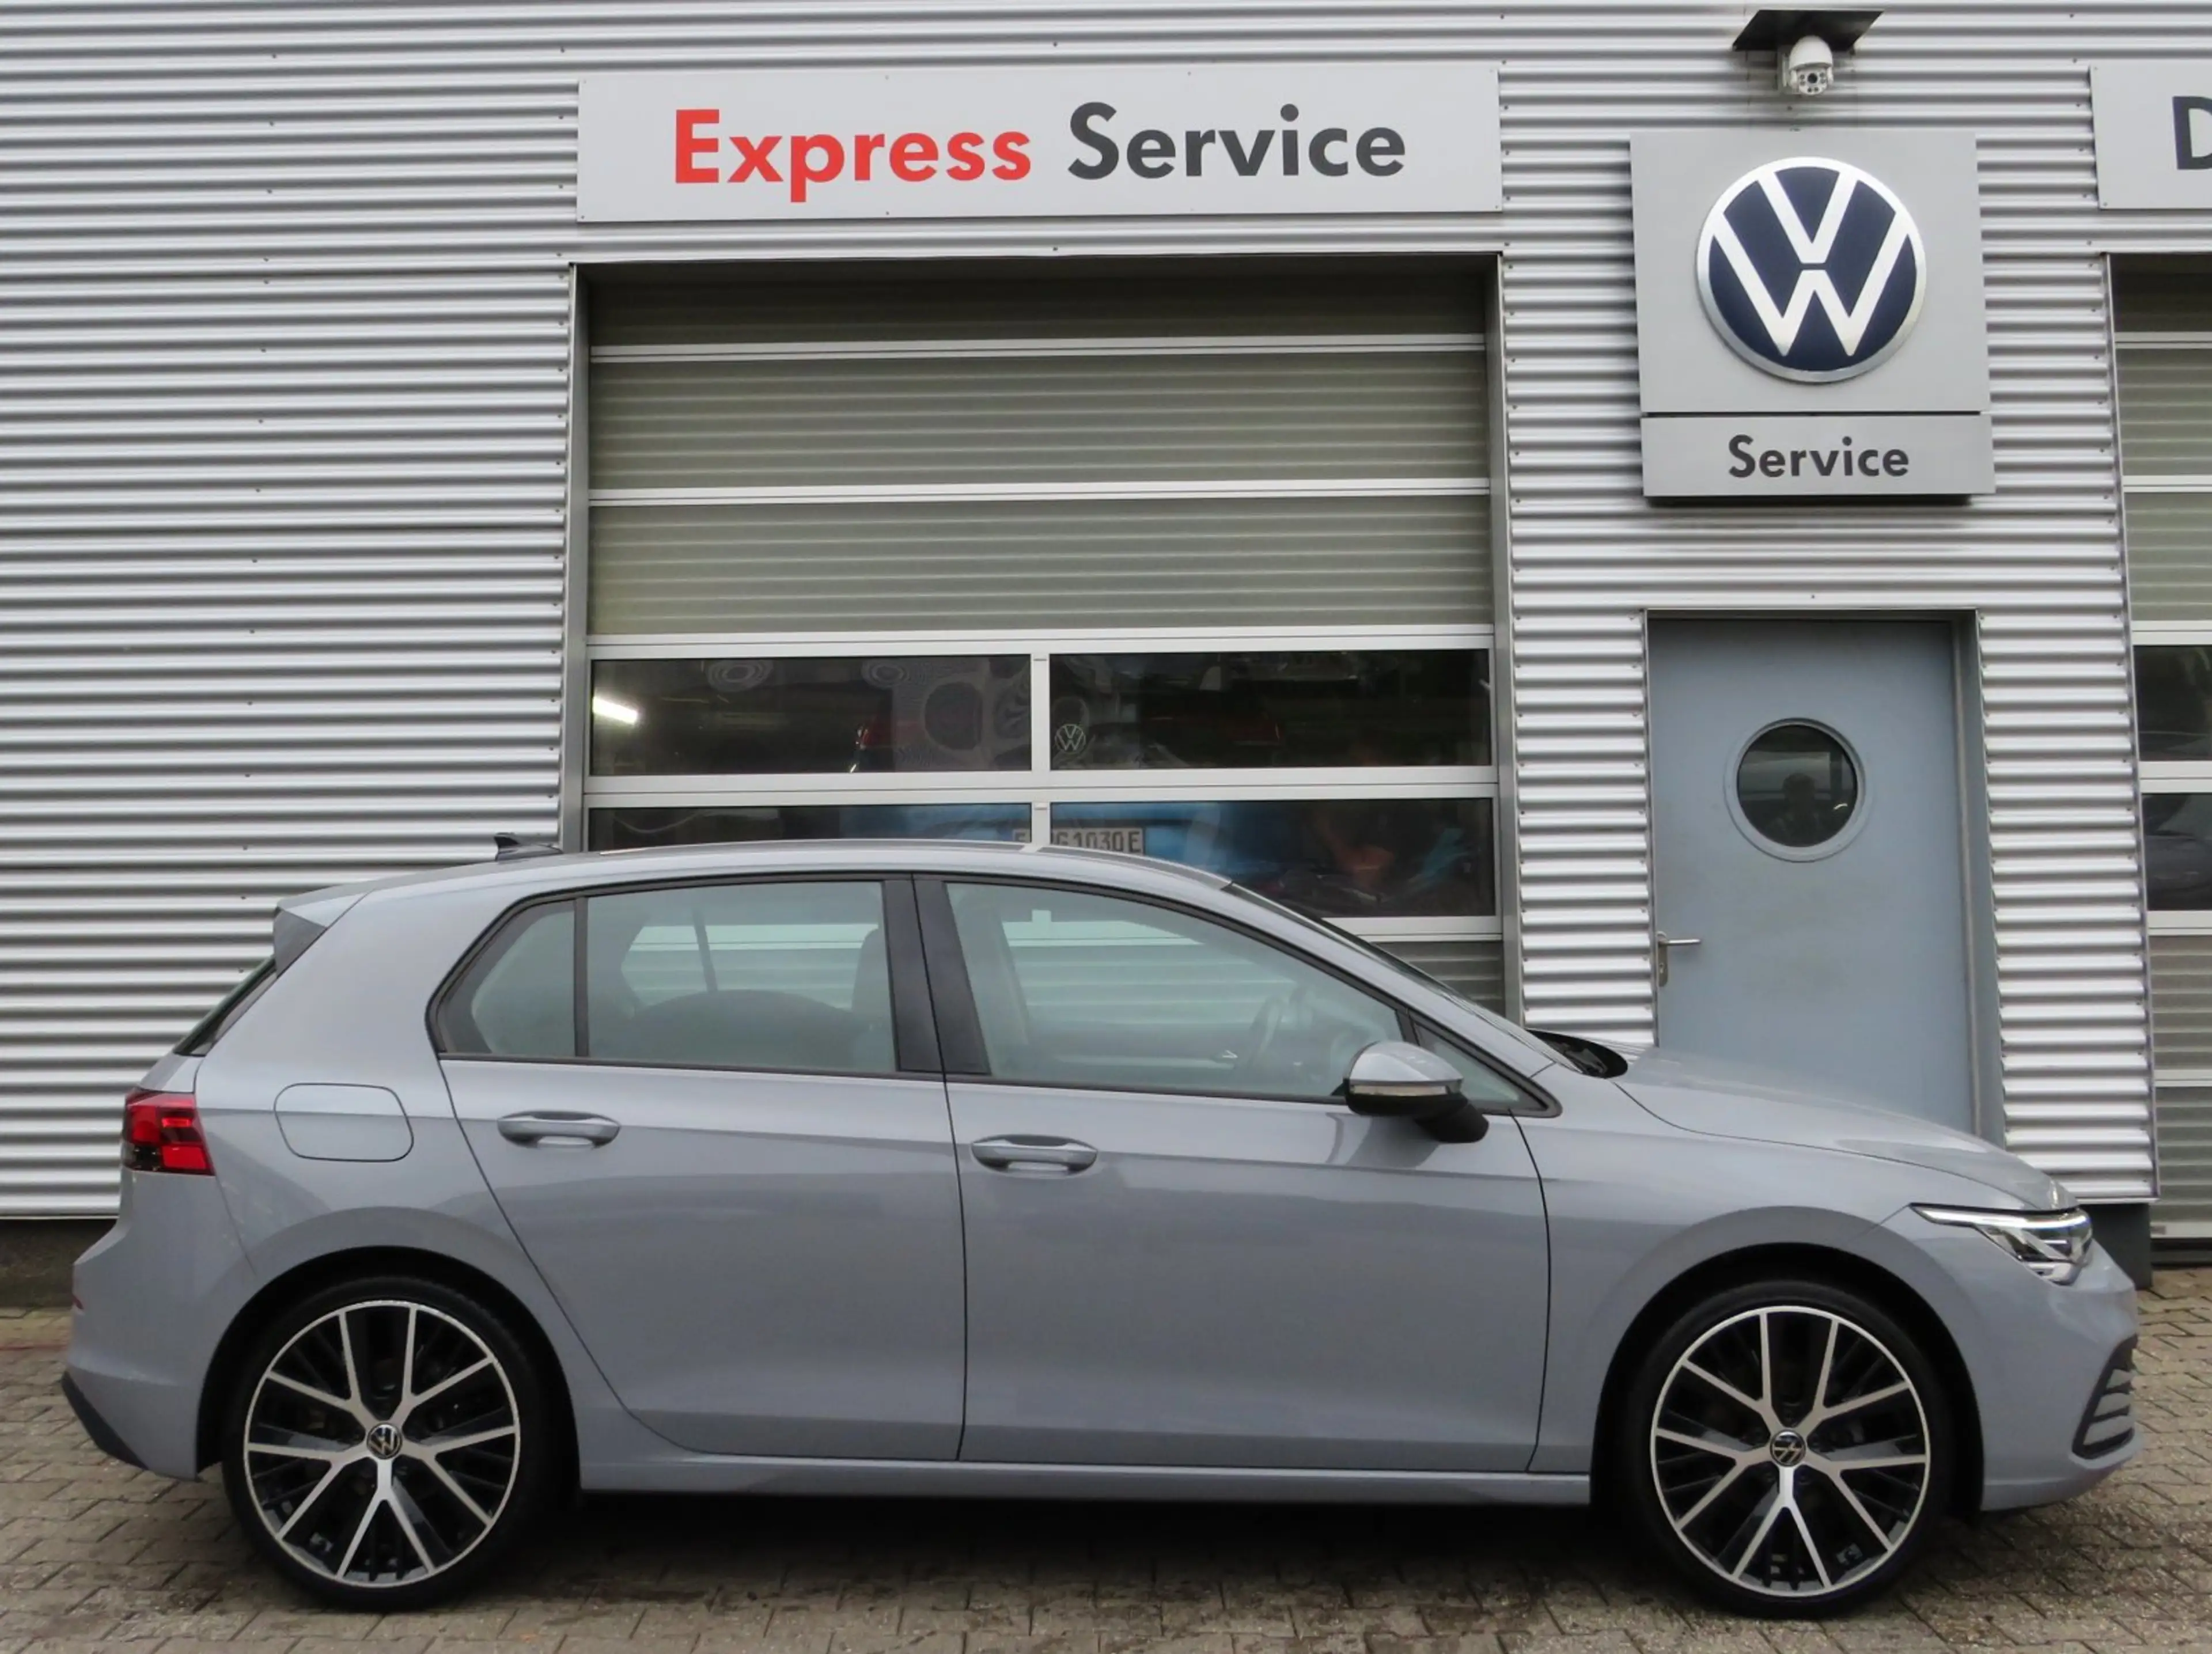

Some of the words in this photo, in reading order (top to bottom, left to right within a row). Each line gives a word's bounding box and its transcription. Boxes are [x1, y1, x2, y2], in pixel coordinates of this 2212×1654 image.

[675, 108, 1031, 204] Express
[1068, 102, 1405, 180] Service
[1729, 434, 1909, 478] Service
